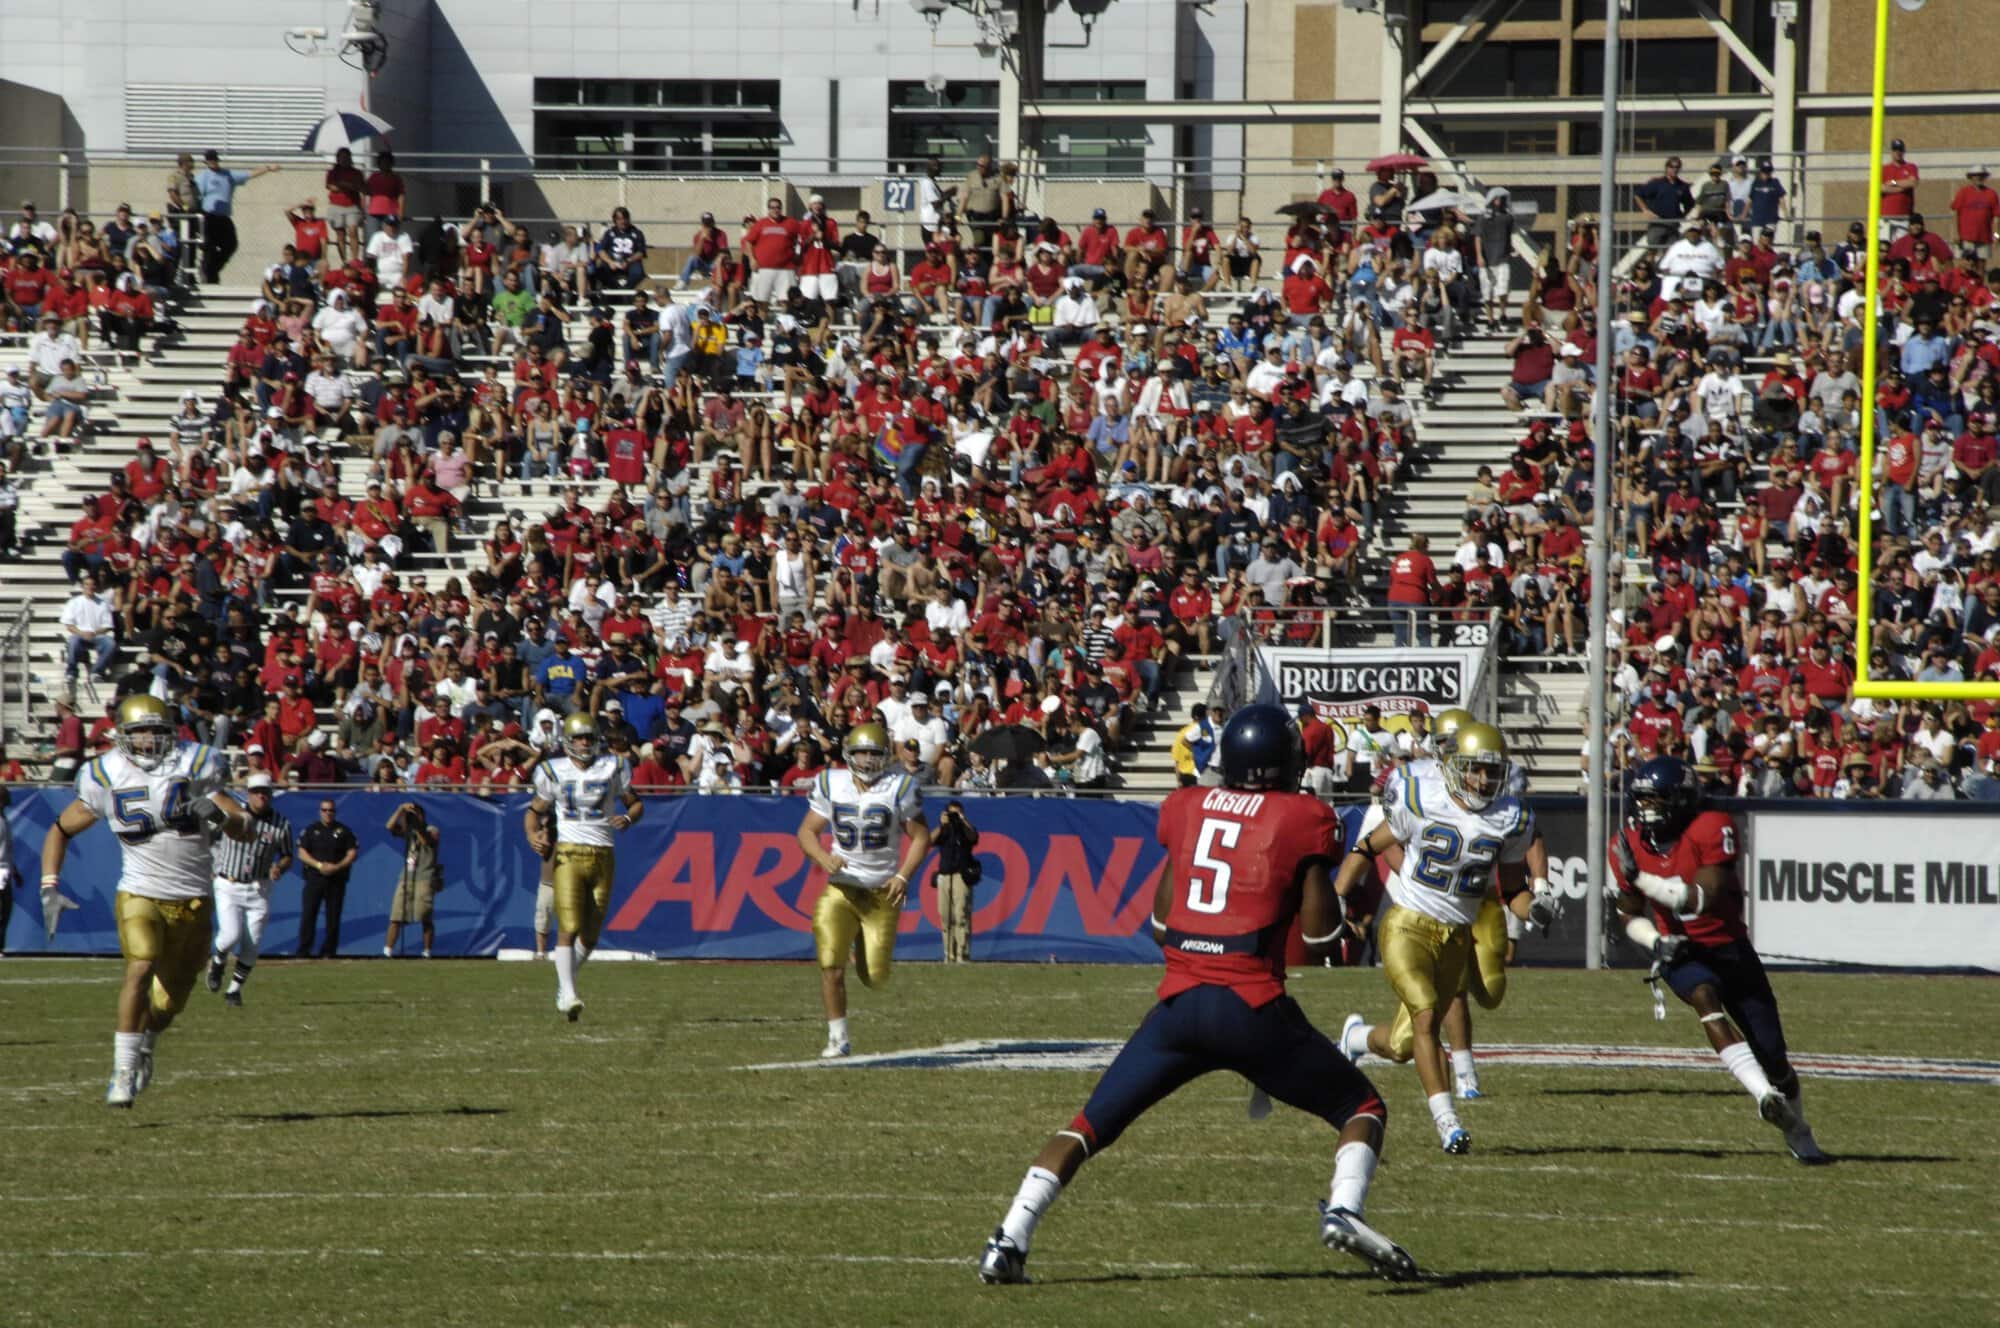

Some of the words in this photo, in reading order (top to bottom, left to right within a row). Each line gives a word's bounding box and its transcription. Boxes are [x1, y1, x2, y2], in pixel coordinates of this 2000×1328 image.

[887, 182, 910, 208] 27
[1454, 625, 1489, 646] 28
[1283, 666, 1459, 699] BRUEGGER'S
[111, 776, 199, 847] 54
[562, 780, 610, 822] 17
[1202, 787, 1265, 817] CASON
[832, 801, 893, 851] 52
[1186, 817, 1243, 915] 5
[1411, 821, 1504, 897] 22
[1759, 859, 1915, 904] MUSCLE
[1926, 861, 2000, 905] MIL
[1180, 939, 1225, 955] ARIZONA
